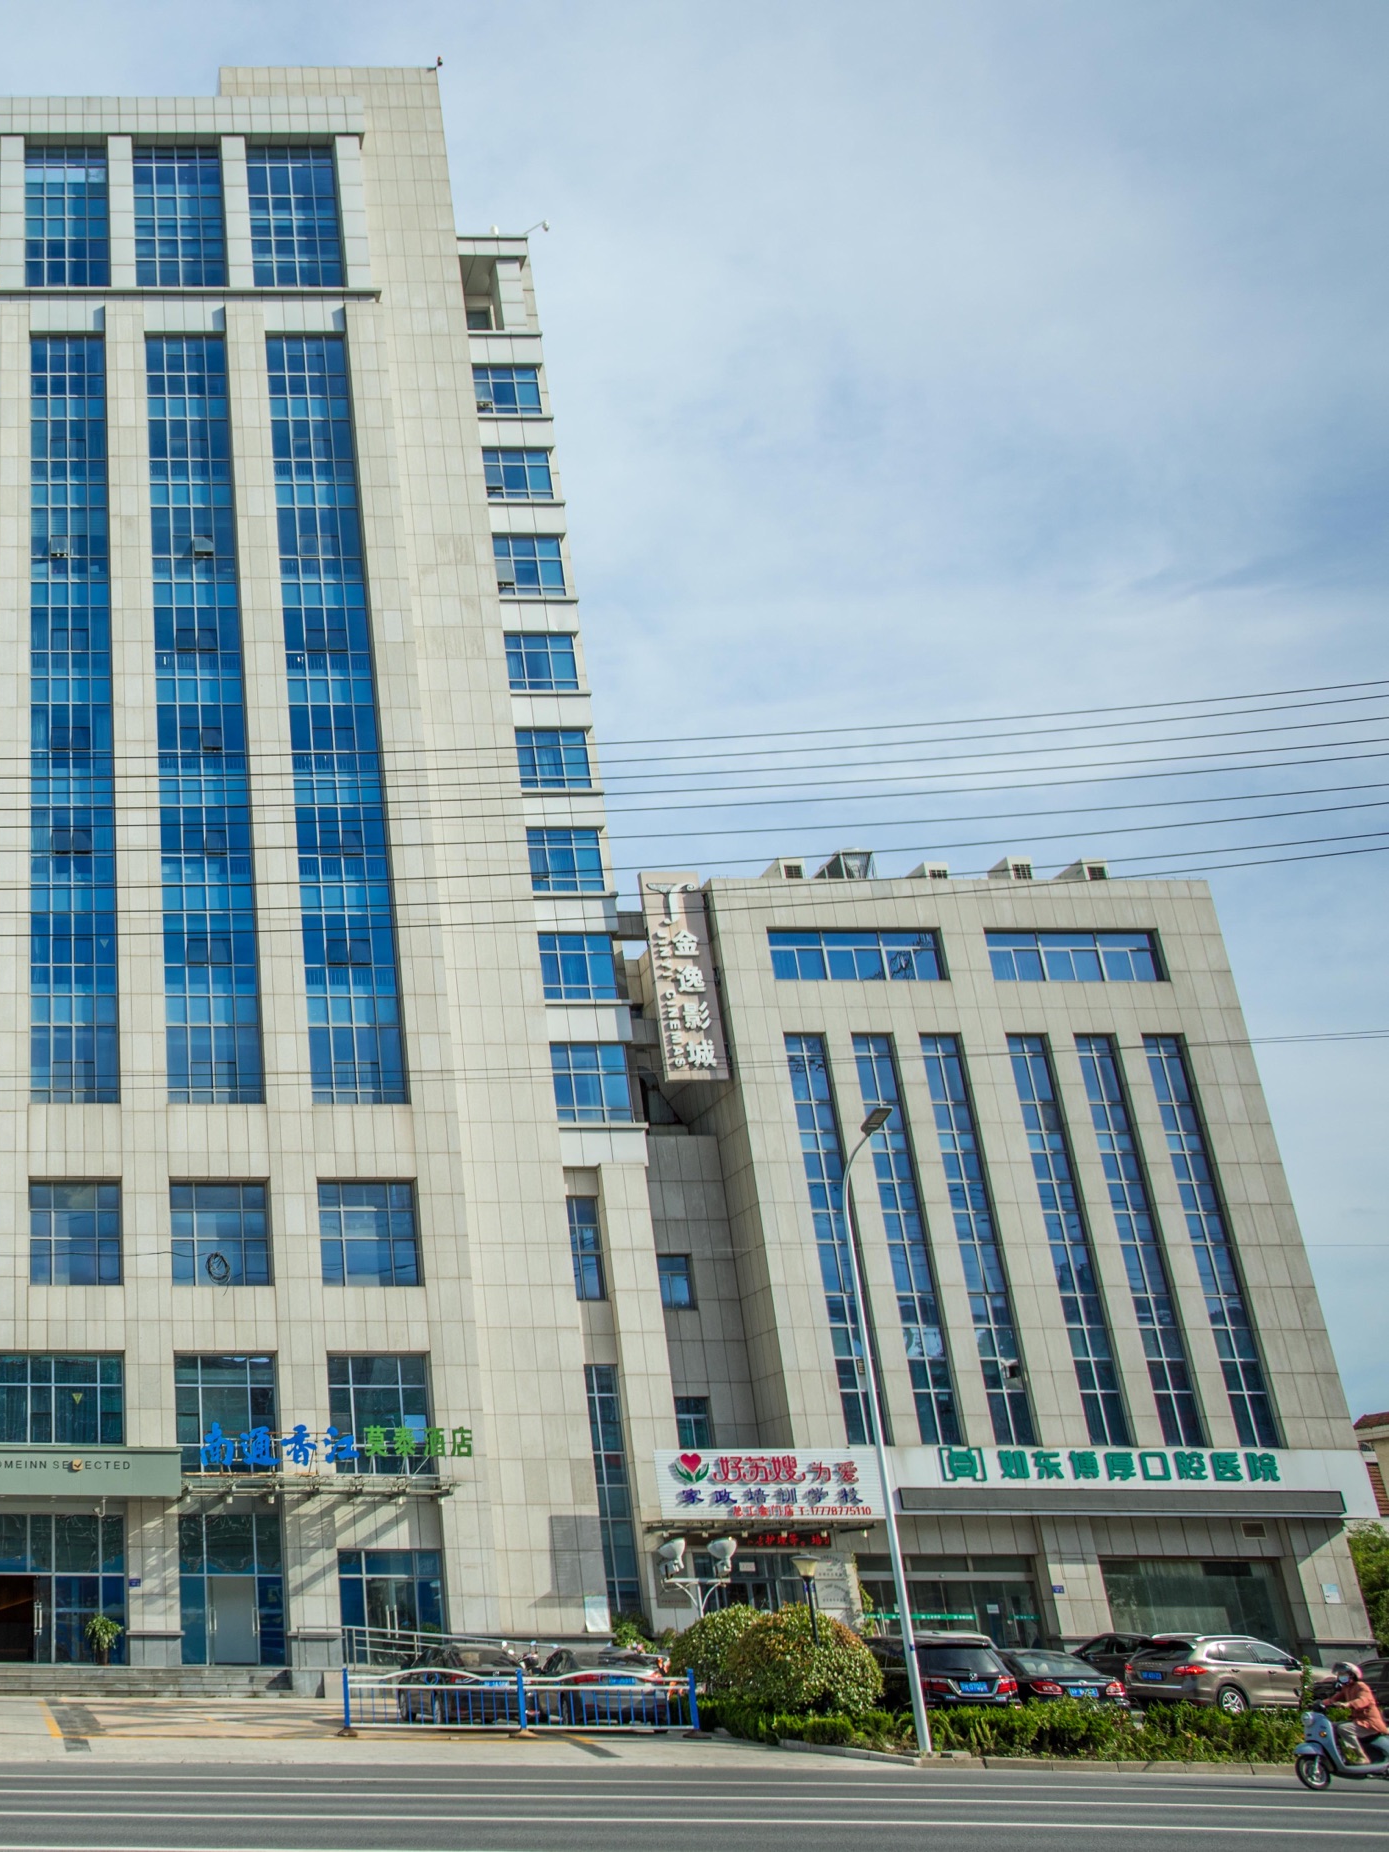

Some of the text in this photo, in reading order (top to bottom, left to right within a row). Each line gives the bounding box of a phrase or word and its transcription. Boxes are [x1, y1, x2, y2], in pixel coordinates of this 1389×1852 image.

[656, 931, 687, 1067] JINYI CINEMAS
[672, 930, 717, 1067] 金逸影城
[200, 1421, 473, 1467] 南通香江 莫泰酒店
[53, 1460, 132, 1471] SEECTED
[712, 1455, 860, 1485] 好苏嫂 为爱
[997, 1449, 1282, 1482] 如东博厚口腔医院
[681, 1487, 864, 1505] 家政培训学校
[733, 1505, 794, 1516] 总工会门店
